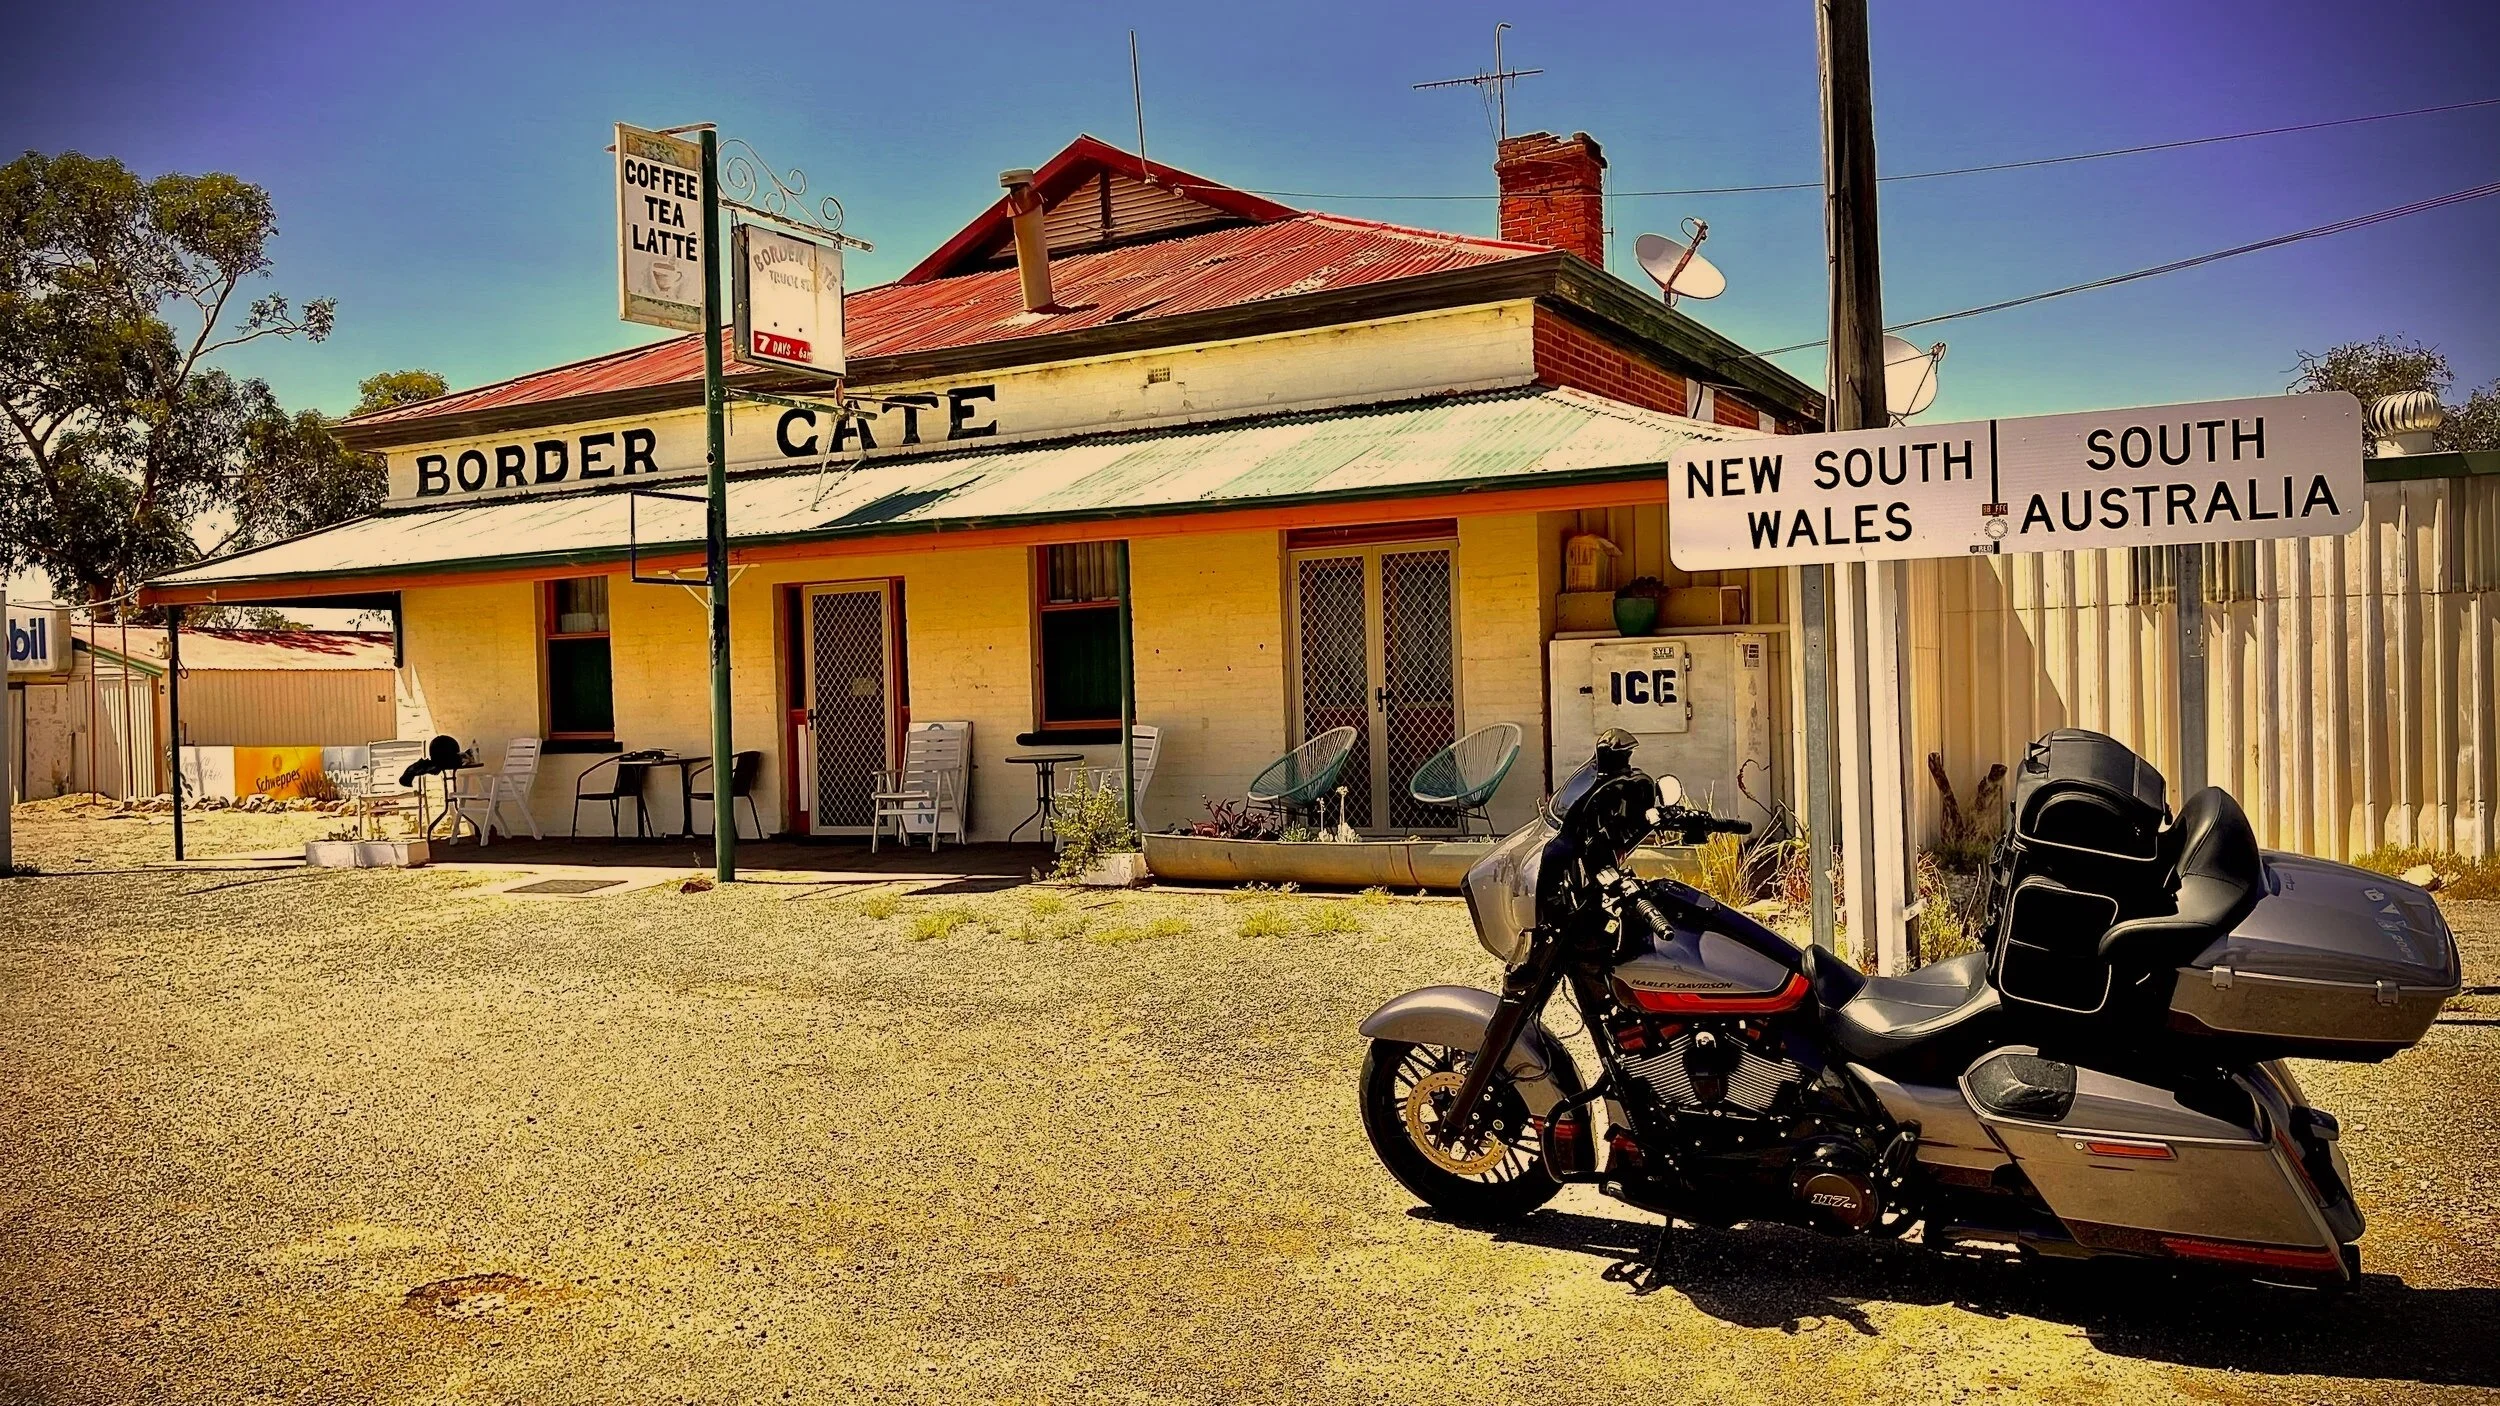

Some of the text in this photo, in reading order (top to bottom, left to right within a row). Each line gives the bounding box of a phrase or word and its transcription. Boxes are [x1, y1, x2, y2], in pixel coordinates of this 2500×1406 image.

[624, 158, 698, 201] COFFEE
[644, 194, 685, 228] TEA
[632, 223, 698, 262] LATTÉ
[807, 250, 838, 291] GTE
[757, 335, 771, 353] 7
[772, 341, 791, 356] DAYS
[415, 384, 999, 498] BORDER GATE
[2085, 417, 2267, 471] SOUTH
[1686, 440, 1974, 499] NEW SOUTH
[2020, 474, 2341, 535] AUSTRALIA
[1747, 503, 1913, 550] WALES
[6, 617, 47, 661] bil
[1610, 669, 1678, 707] ICE
[256, 768, 301, 794] Schweppes
[1631, 979, 1733, 989] HARLEY-DAVIDSON
[1811, 1193, 1850, 1207] 117
